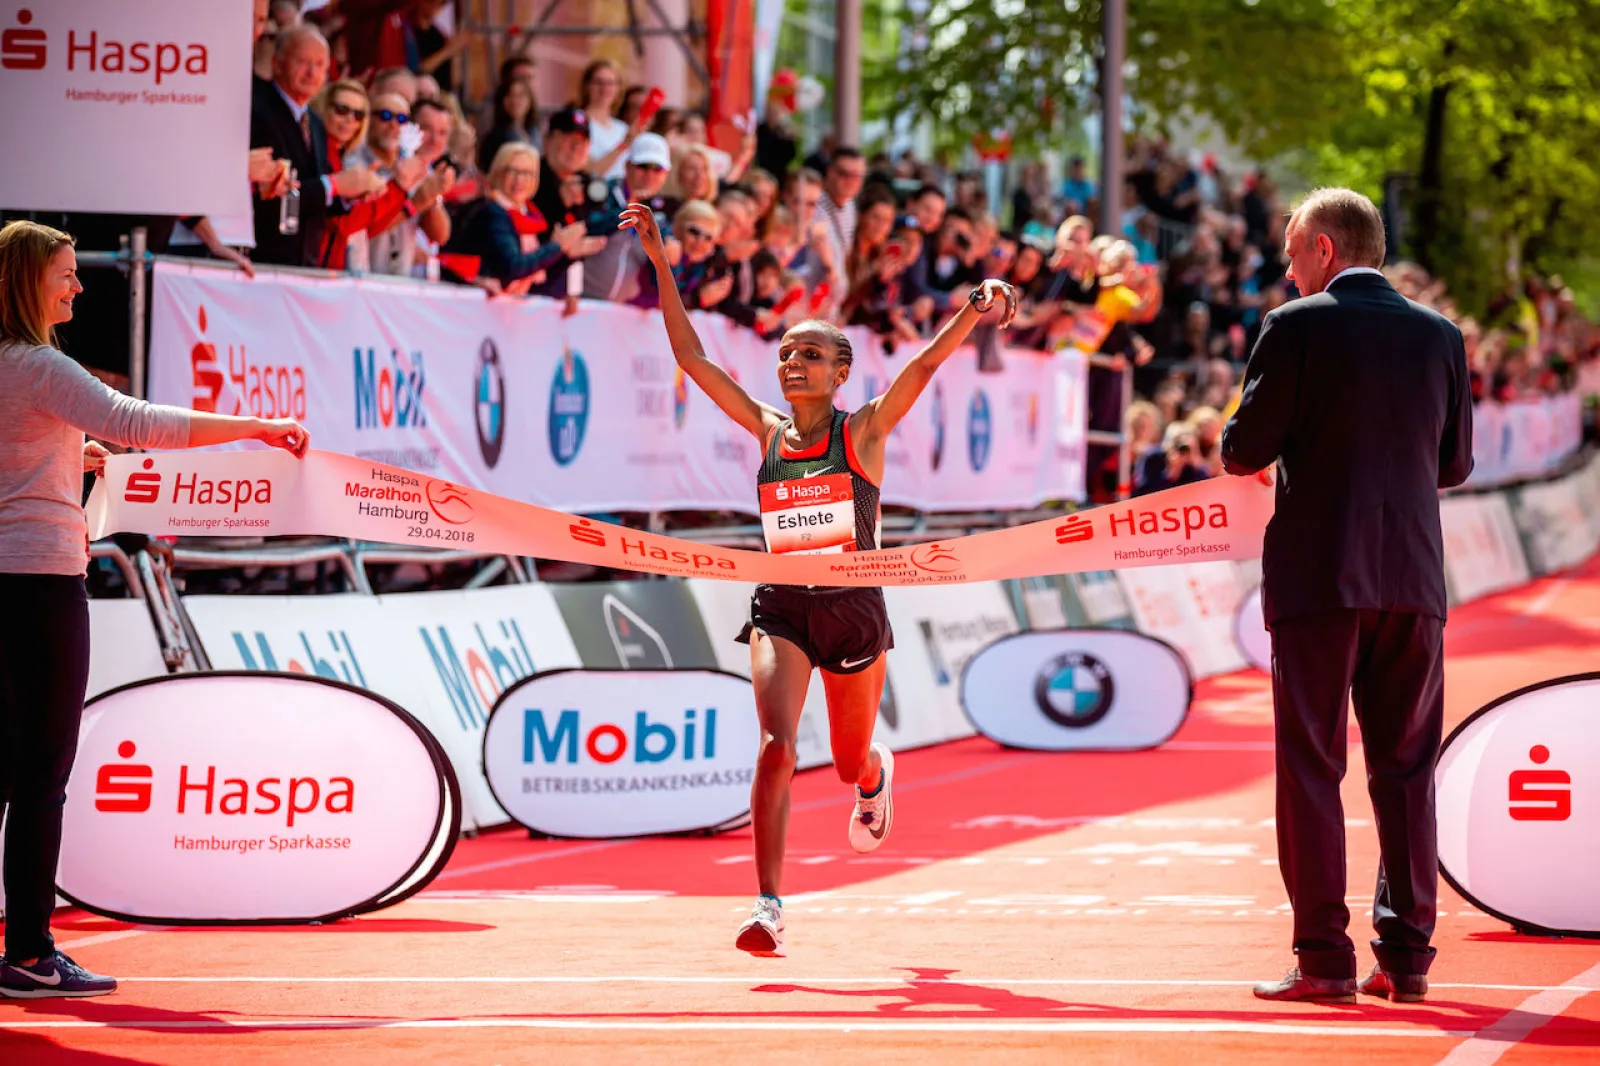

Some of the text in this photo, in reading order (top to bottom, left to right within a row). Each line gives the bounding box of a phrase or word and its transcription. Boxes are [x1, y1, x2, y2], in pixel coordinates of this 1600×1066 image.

[67, 30, 208, 84] Haspa
[66, 88, 208, 105] Hamburger Sparkasse
[229, 344, 306, 421] Haspa
[371, 468, 420, 487] Haspa
[172, 473, 271, 513] Haspa
[345, 482, 421, 503] Marathon
[791, 484, 831, 498] Haspa
[168, 516, 270, 529] Hamburger Sparkasse
[358, 502, 429, 524] Hamburg
[777, 511, 834, 530] Eshete
[1109, 503, 1229, 540] Haspa
[407, 526, 475, 543] 29.04.2018
[620, 536, 737, 570] Haspa
[853, 553, 904, 562] Haspa
[1114, 542, 1231, 561] Hamburger Sparkasse
[624, 559, 684, 574] Hamburger
[830, 562, 908, 572] Marathon
[846, 569, 918, 578] Hamburg
[522, 708, 717, 764] Mobil
[177, 765, 355, 828] Haspa
[174, 834, 351, 855] Hamburger Sparkasse
